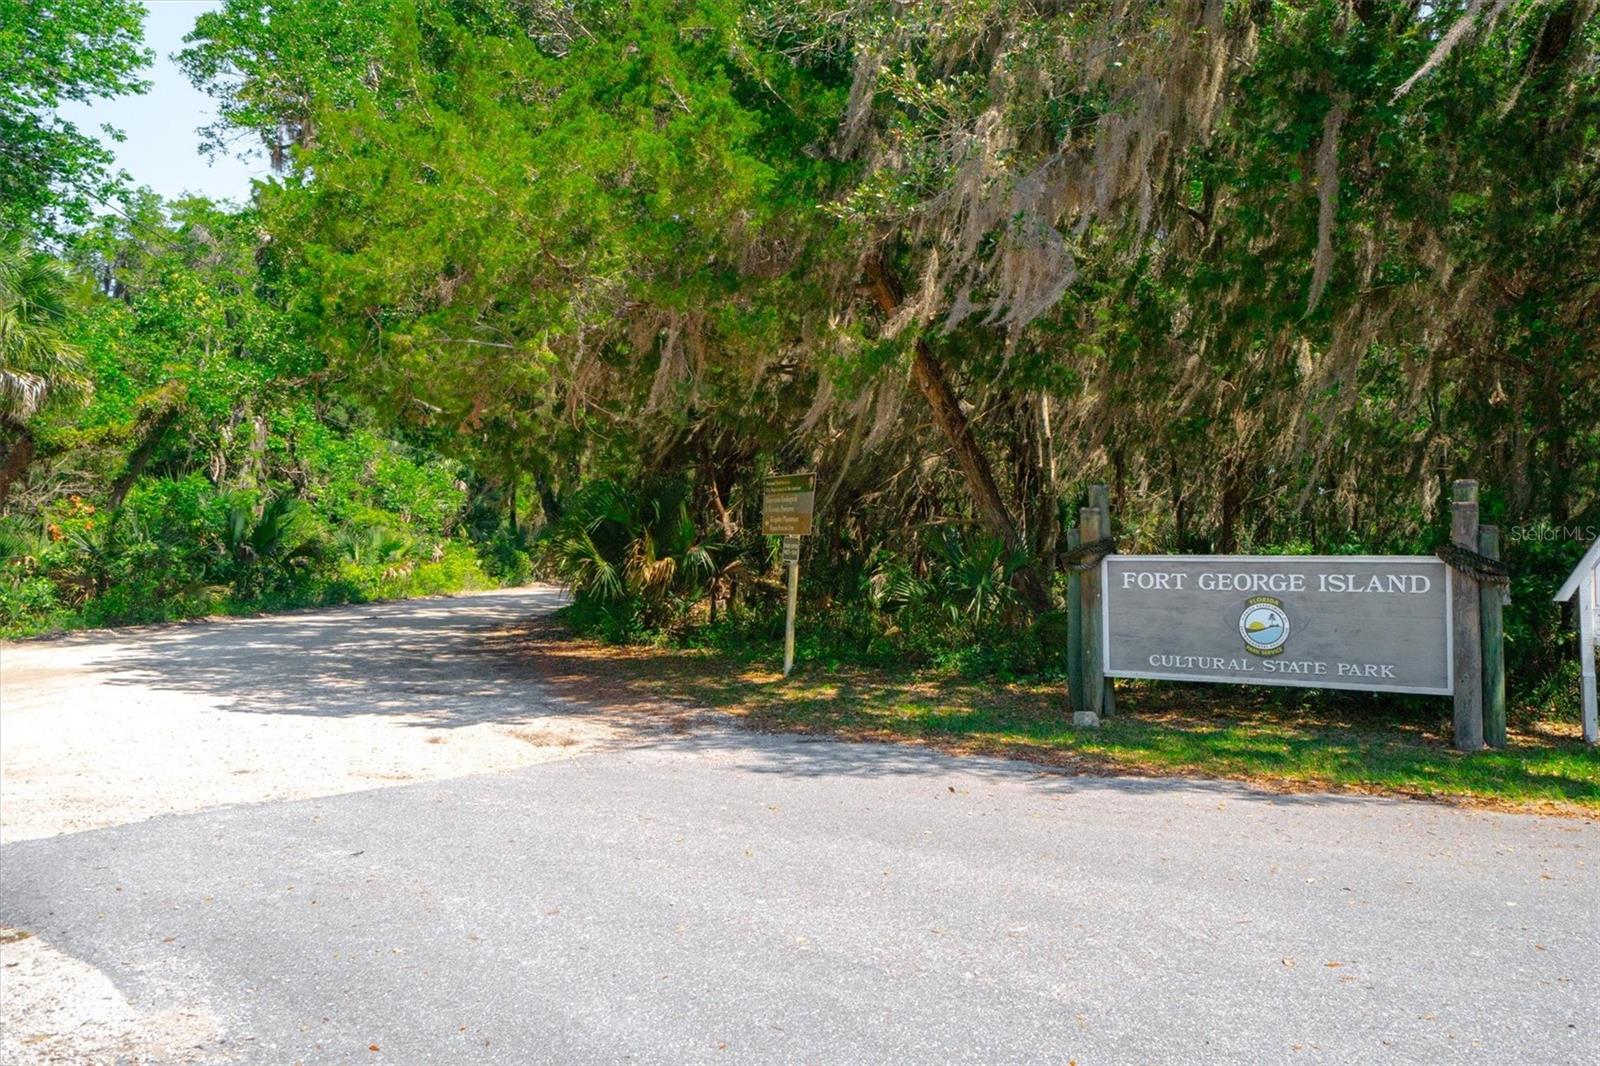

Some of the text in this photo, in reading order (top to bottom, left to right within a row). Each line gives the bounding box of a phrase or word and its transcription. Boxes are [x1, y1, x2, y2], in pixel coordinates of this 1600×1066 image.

[1121, 571, 1431, 594] FORT GEORGE ISLAND
[1249, 597, 1279, 605] FLORIDA
[1148, 654, 1396, 679] CULTURAL STATE PARK
